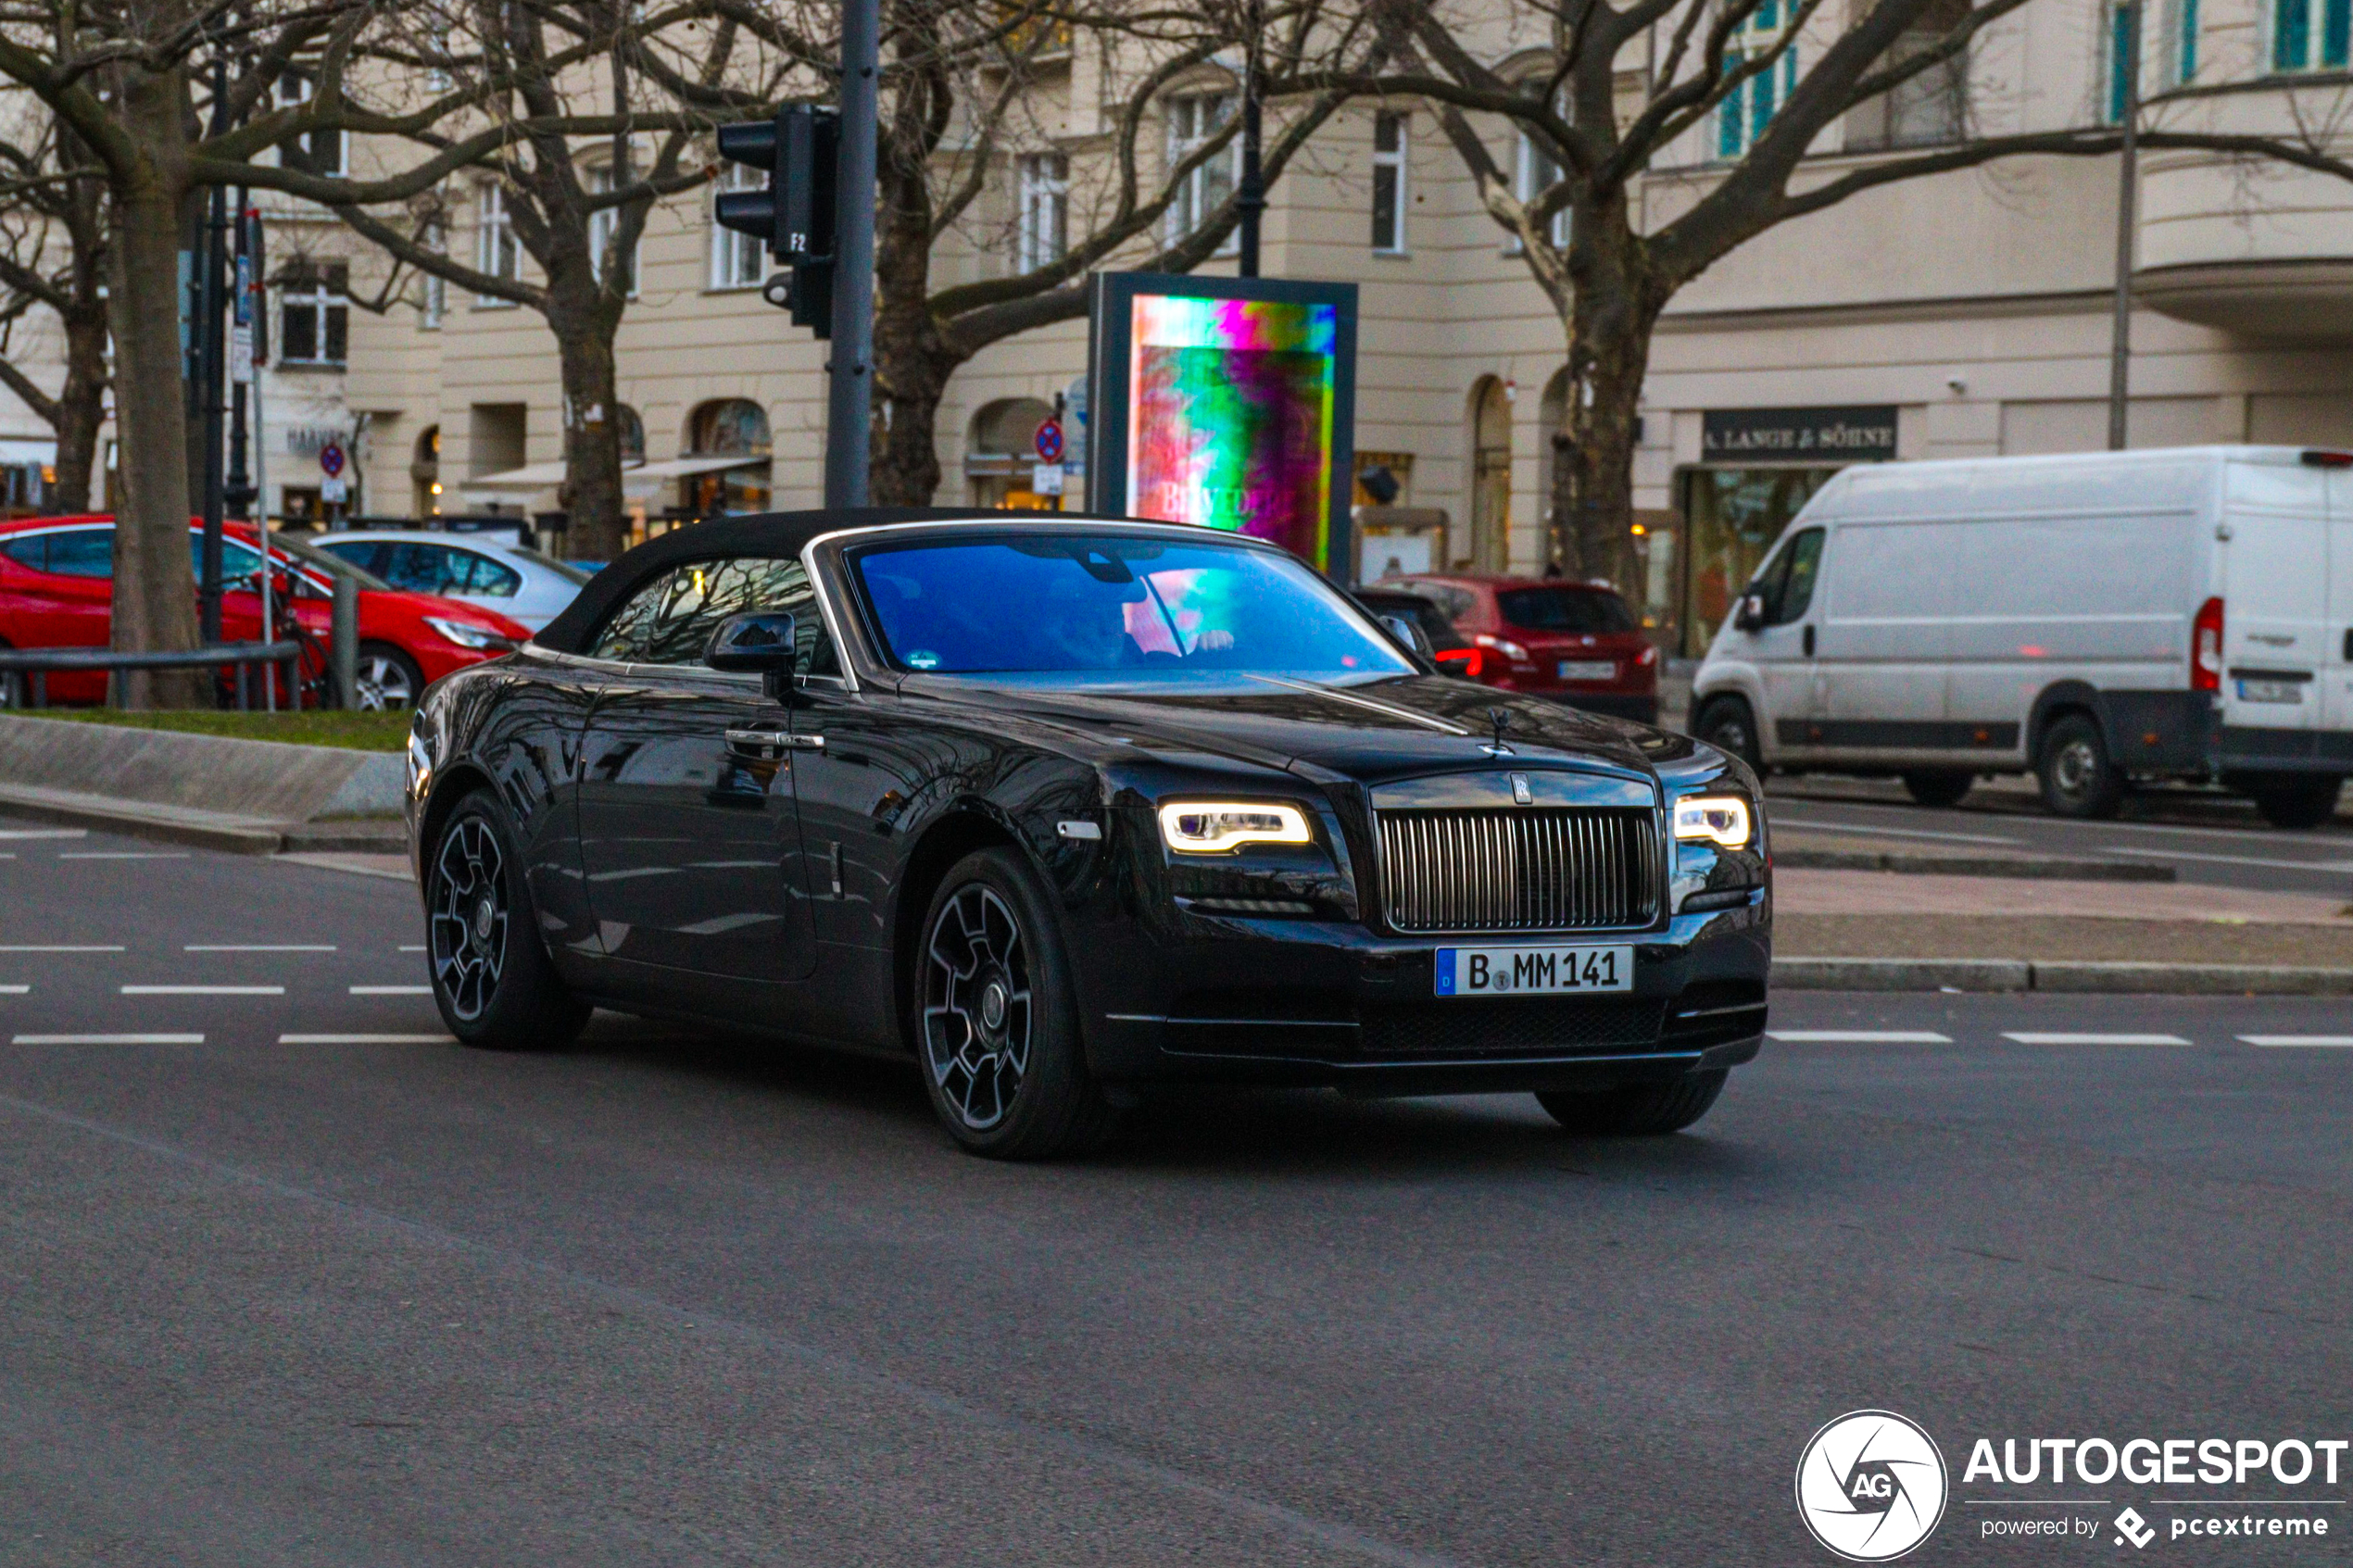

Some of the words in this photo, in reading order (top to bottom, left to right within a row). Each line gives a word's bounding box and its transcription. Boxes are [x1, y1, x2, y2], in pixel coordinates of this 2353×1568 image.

[790, 232, 806, 251] F2
[1724, 429, 1794, 449] LANGE
[1799, 428, 1814, 449] &
[1819, 423, 1893, 448] SÖHNE
[1441, 976, 1451, 987] D
[1469, 954, 1490, 989] B
